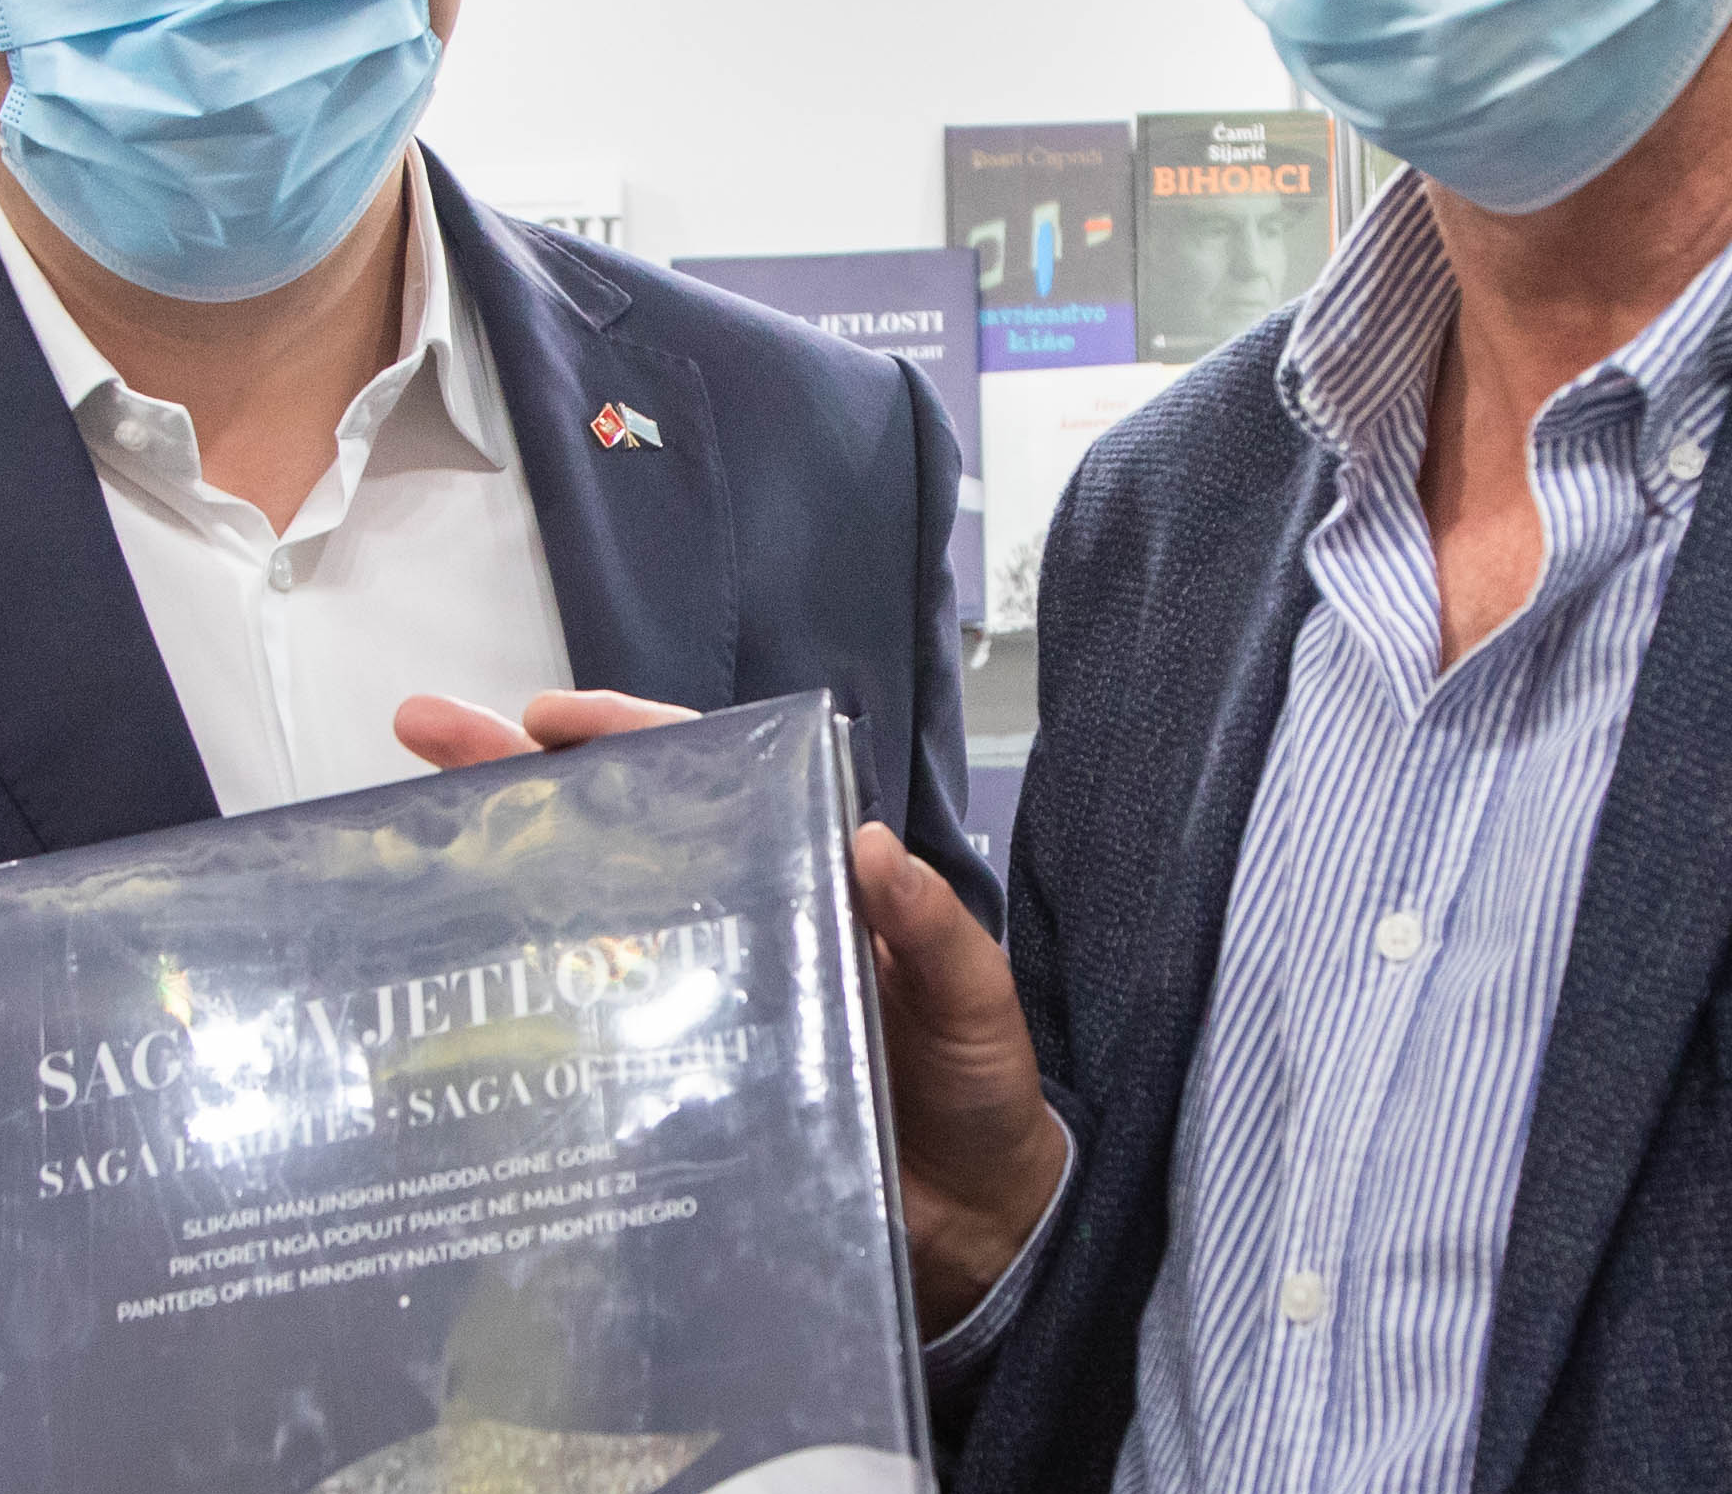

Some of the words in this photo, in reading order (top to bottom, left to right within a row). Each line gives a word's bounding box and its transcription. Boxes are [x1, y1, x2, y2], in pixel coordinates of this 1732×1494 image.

[1153, 165, 1312, 196] BIHORCI
[38, 1142, 159, 1199] SAGA
[409, 1071, 532, 1127] SAGA
[182, 1208, 261, 1240] SLIKARI
[264, 1182, 395, 1224] MANJINSKIH
[398, 1164, 491, 1199] NARODA
[493, 1150, 553, 1182] CRNE
[272, 1231, 319, 1257] NGA
[323, 1214, 405, 1249] POPUJT
[408, 1197, 483, 1233] PAKICE
[117, 1284, 217, 1323] PAINTERS
[220, 1279, 251, 1303] OF
[252, 1270, 296, 1296] THE
[300, 1253, 401, 1288] MINORITY
[406, 1231, 504, 1269] NATIONS
[505, 1225, 535, 1250] OF
[539, 1195, 699, 1245] MONTENEGRO
